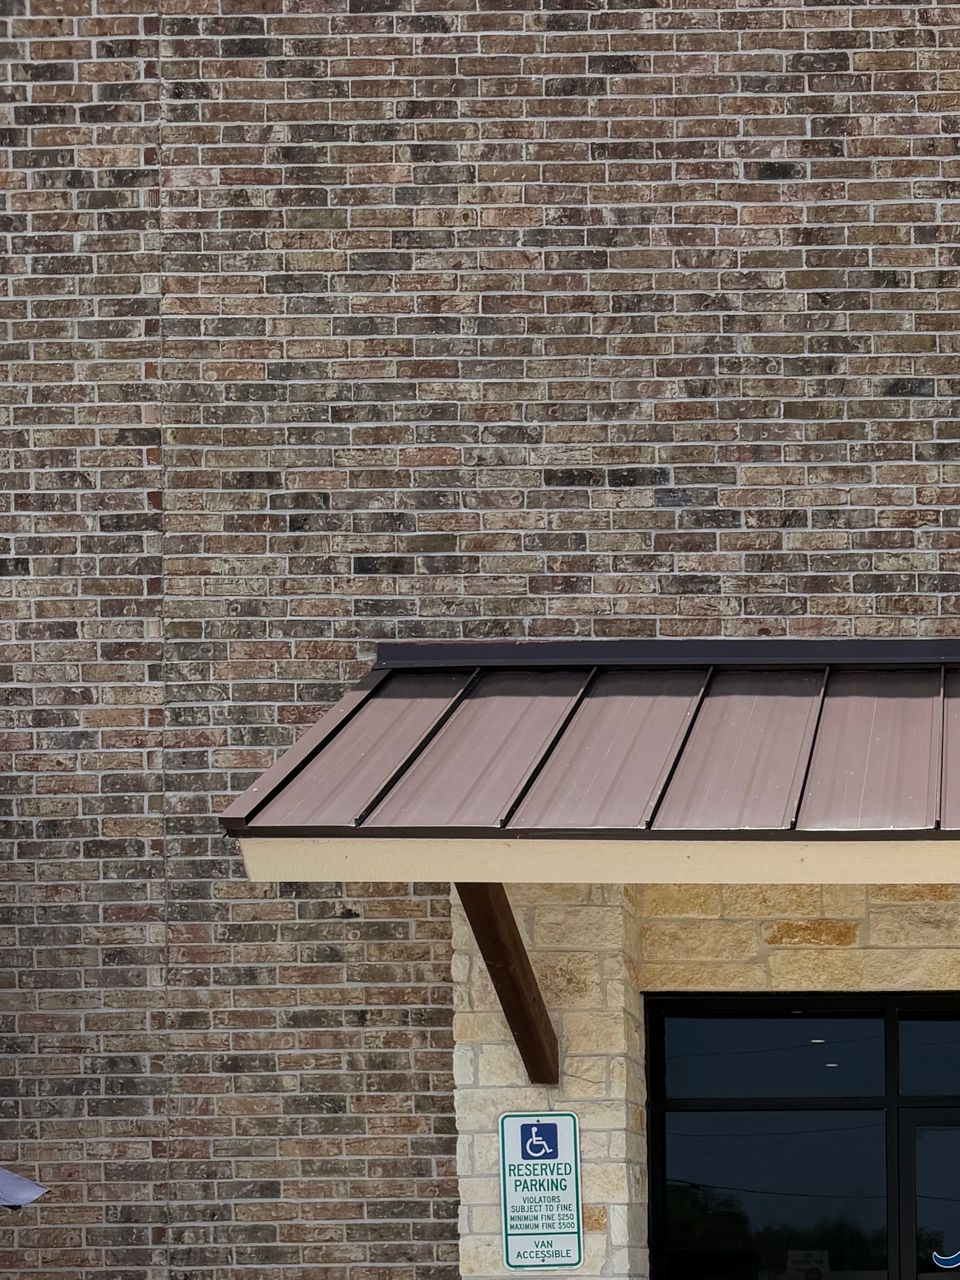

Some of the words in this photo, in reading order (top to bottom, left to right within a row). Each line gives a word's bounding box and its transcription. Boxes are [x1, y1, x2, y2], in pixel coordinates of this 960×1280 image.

[508, 1162, 572, 1177] RESERVED
[514, 1178, 567, 1193] PARKING
[522, 1196, 561, 1204] VIOLATORS
[510, 1205, 543, 1213] SUBJECT
[545, 1204, 554, 1212] TO
[556, 1204, 572, 1212] FINE
[510, 1214, 539, 1222] MINIMUM
[540, 1213, 556, 1221] FINE
[557, 1213, 574, 1221] $250
[509, 1222, 539, 1230] MAXIMUM
[558, 1221, 575, 1229] $500
[534, 1240, 553, 1249] VAN
[516, 1250, 572, 1260] ACCESSIBLE
